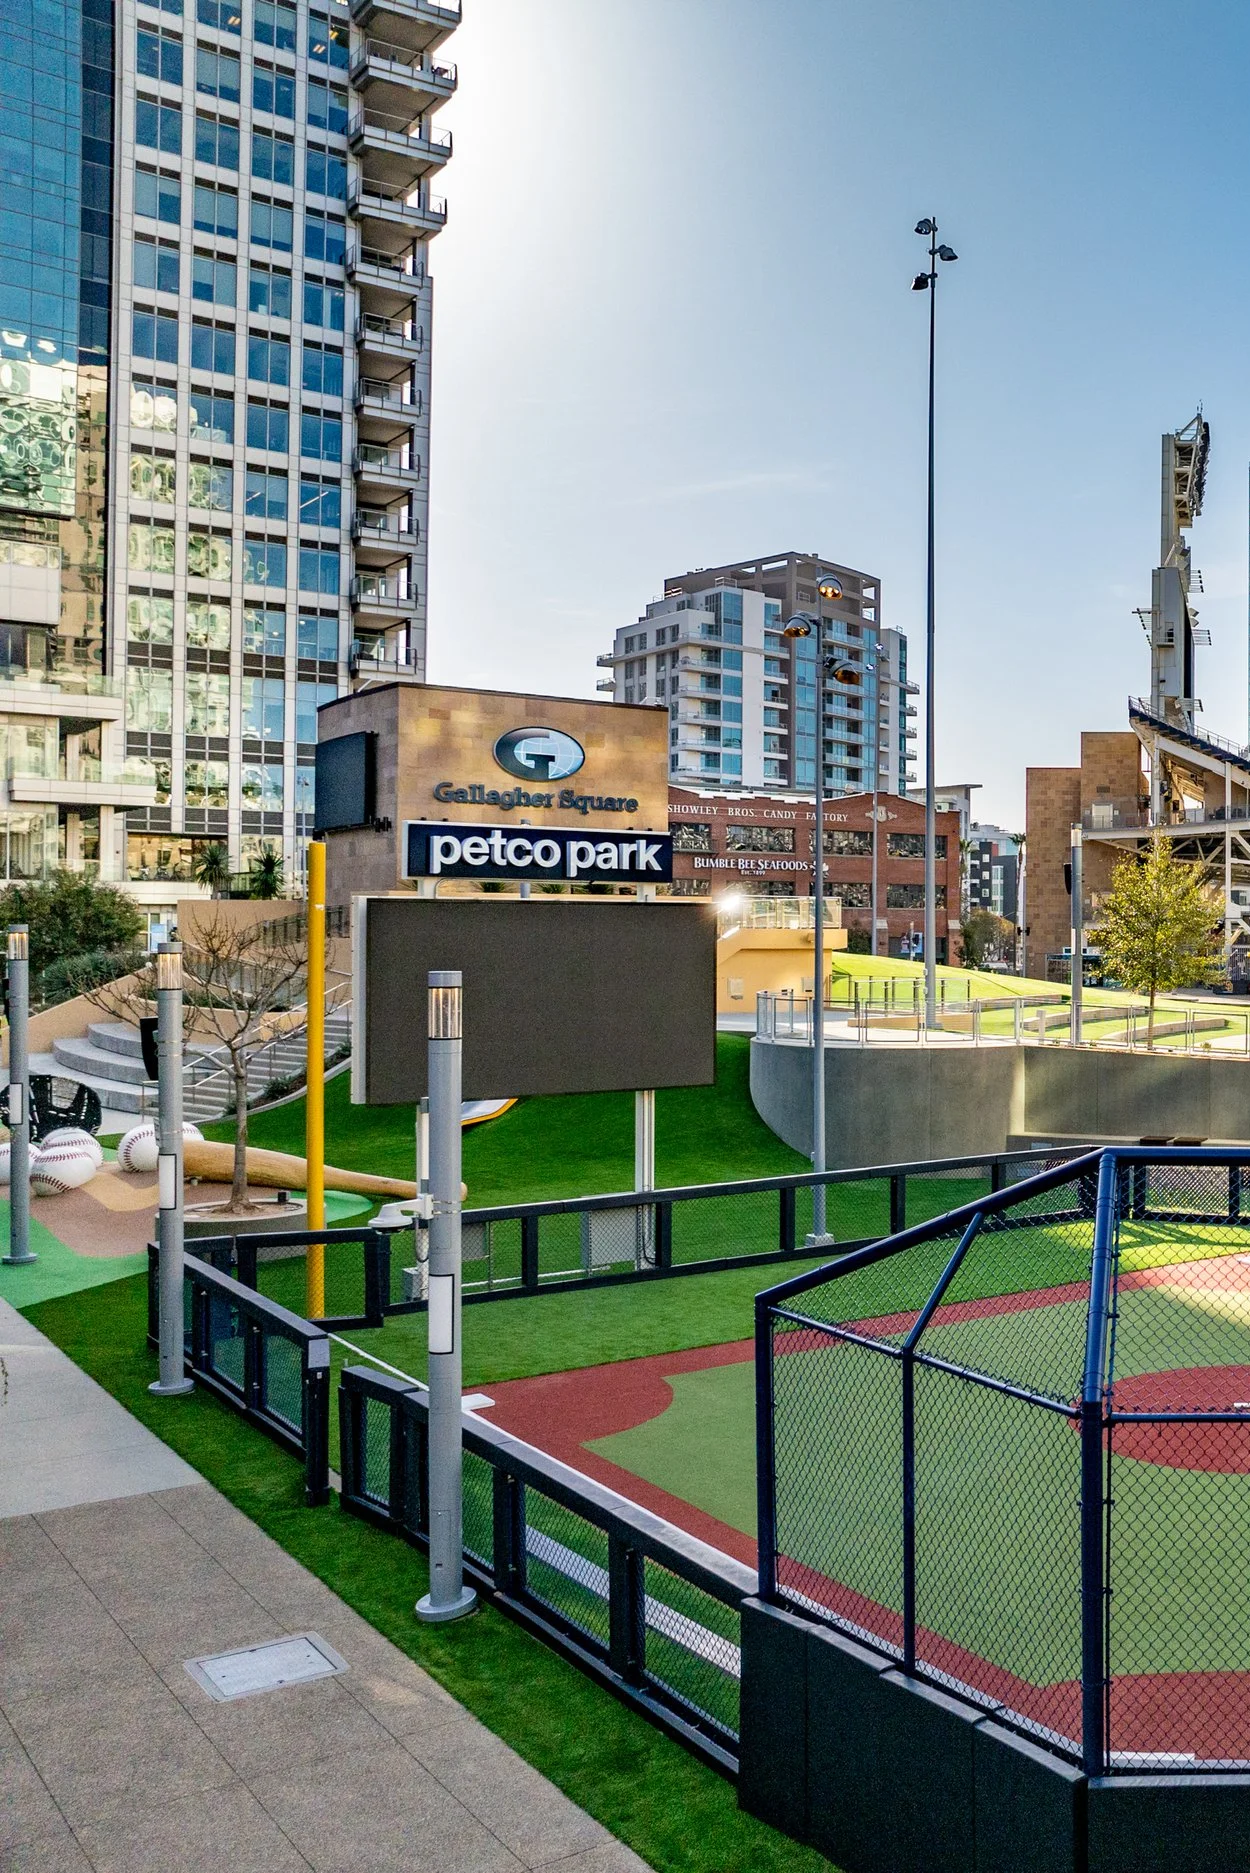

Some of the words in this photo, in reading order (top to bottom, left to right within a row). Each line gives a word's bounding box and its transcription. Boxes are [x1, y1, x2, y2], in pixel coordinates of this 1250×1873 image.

[433, 781, 554, 811] Gallagher
[557, 789, 639, 815] Square
[668, 804, 719, 815] SHOWLEY
[728, 807, 758, 818] BROS.
[763, 809, 798, 820] CANDY
[806, 812, 849, 822] FATORY
[429, 829, 562, 875] petco
[566, 839, 663, 878] park
[694, 856, 736, 869] BUMBLE
[738, 857, 757, 870] BEE
[758, 858, 808, 871] SEAFOODS
